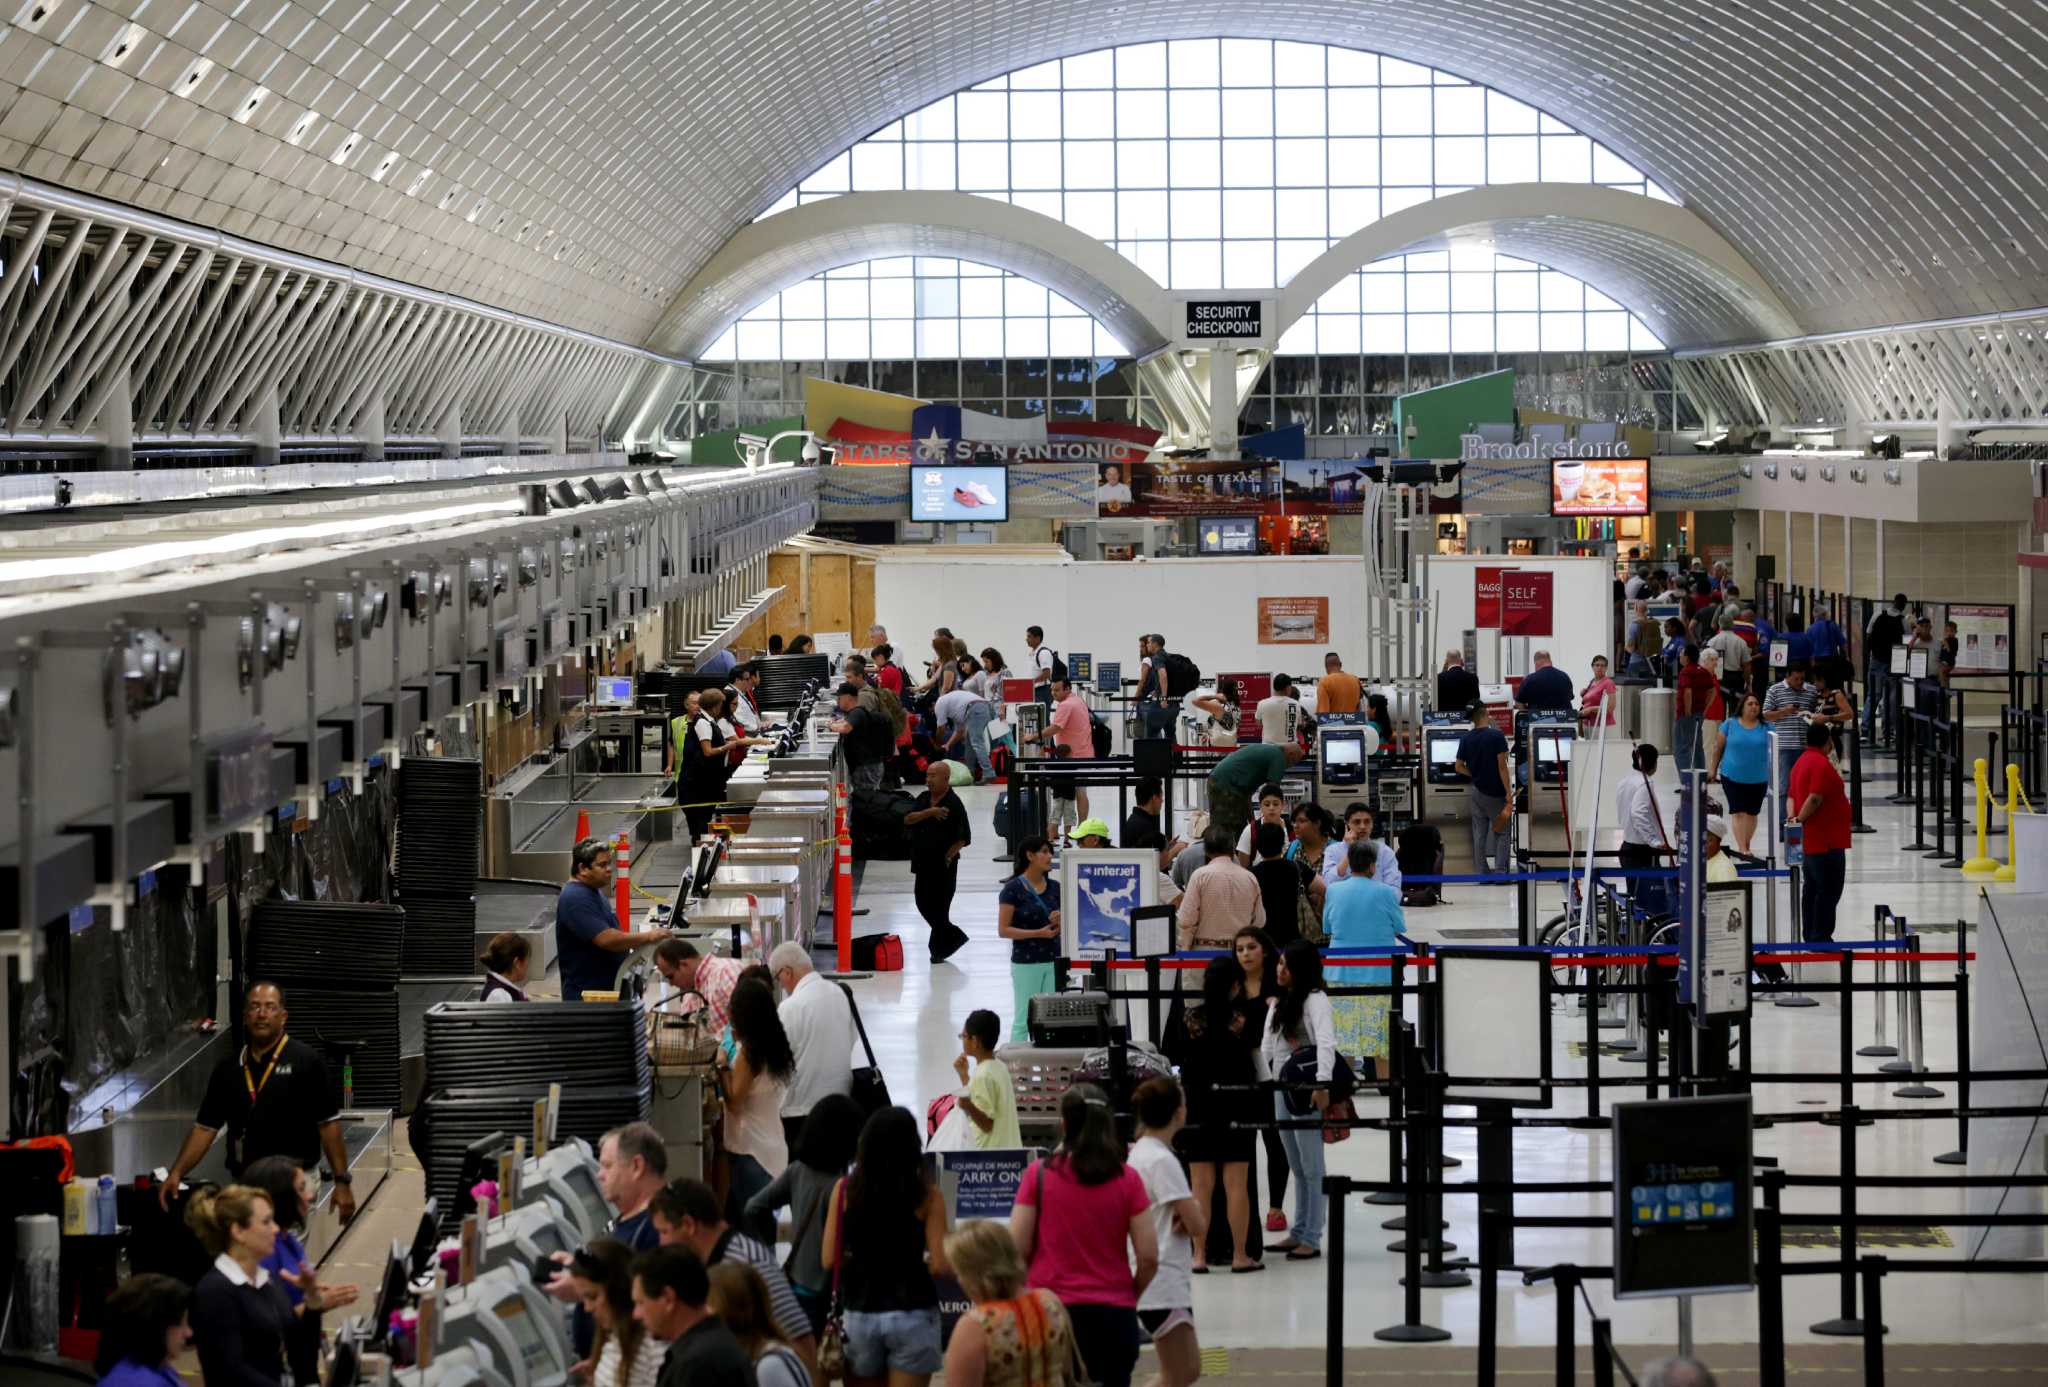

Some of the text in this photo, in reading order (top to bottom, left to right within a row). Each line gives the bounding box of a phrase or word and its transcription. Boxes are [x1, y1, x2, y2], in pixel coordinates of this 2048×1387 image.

[1195, 306, 1251, 319] SECURITY
[1187, 321, 1260, 334] CHECKPOINT
[834, 441, 1129, 461] STARS OF SAN ANTONIO
[1459, 434, 1632, 460] Brookstone
[1156, 473, 1255, 484] TASTE OF TEXAS
[1478, 583, 1501, 592] BAGG
[1507, 587, 1537, 599] SELF
[1093, 865, 1136, 877] interjet
[985, 1162, 996, 1170] DE
[997, 1161, 1021, 1170] MANO
[959, 1171, 1022, 1185] ARRY ON
